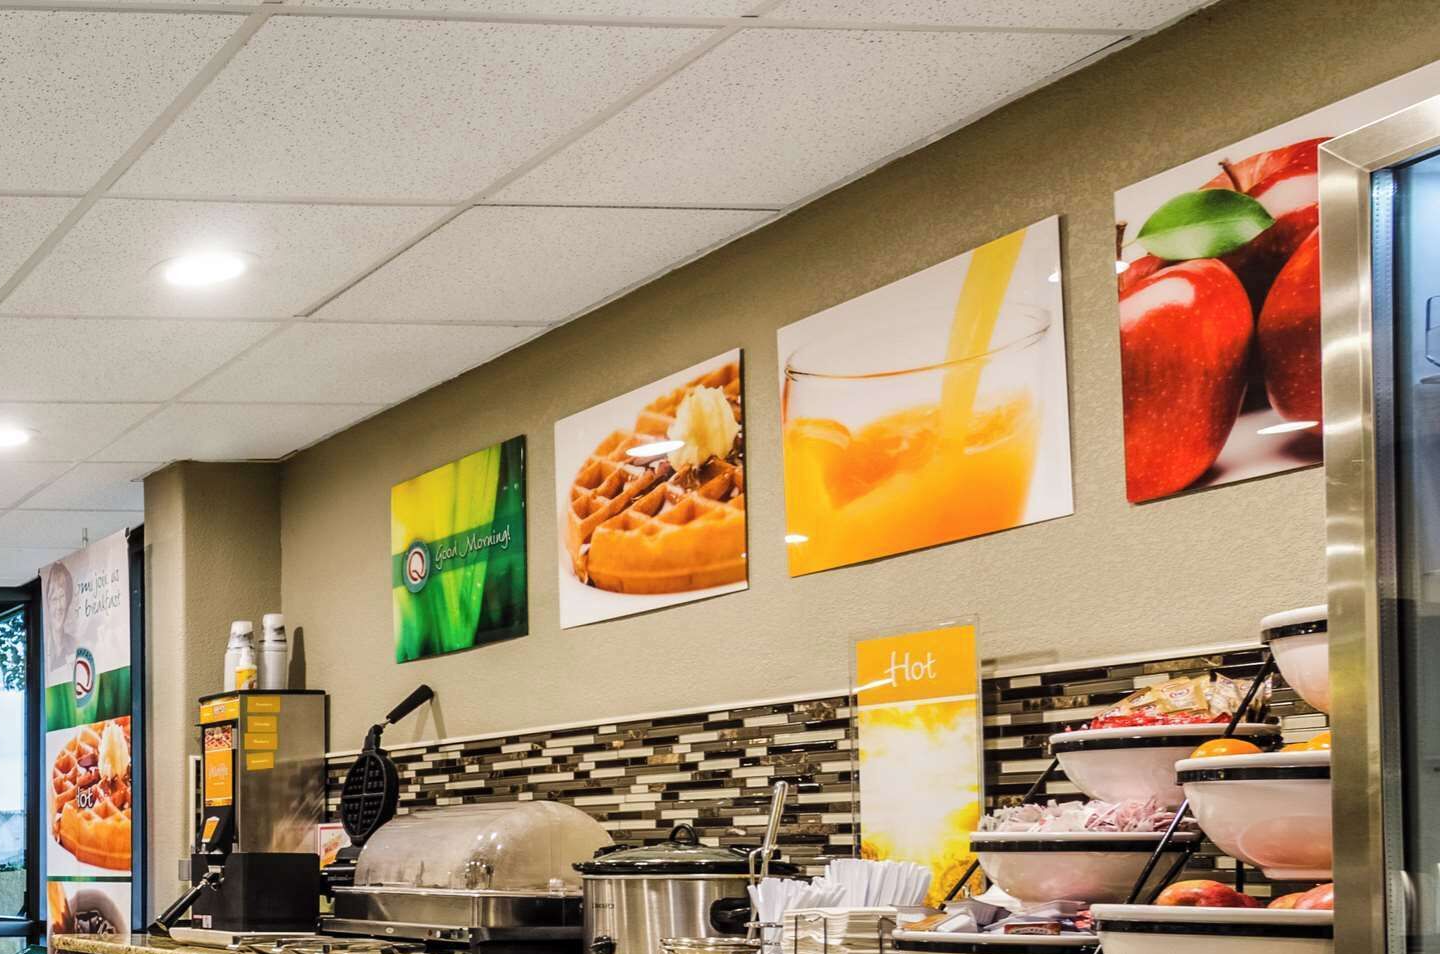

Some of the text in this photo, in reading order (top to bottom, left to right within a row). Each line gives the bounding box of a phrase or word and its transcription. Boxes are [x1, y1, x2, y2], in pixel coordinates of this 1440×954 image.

[435, 524, 511, 570] Good Morning!
[883, 651, 936, 688] Hot
